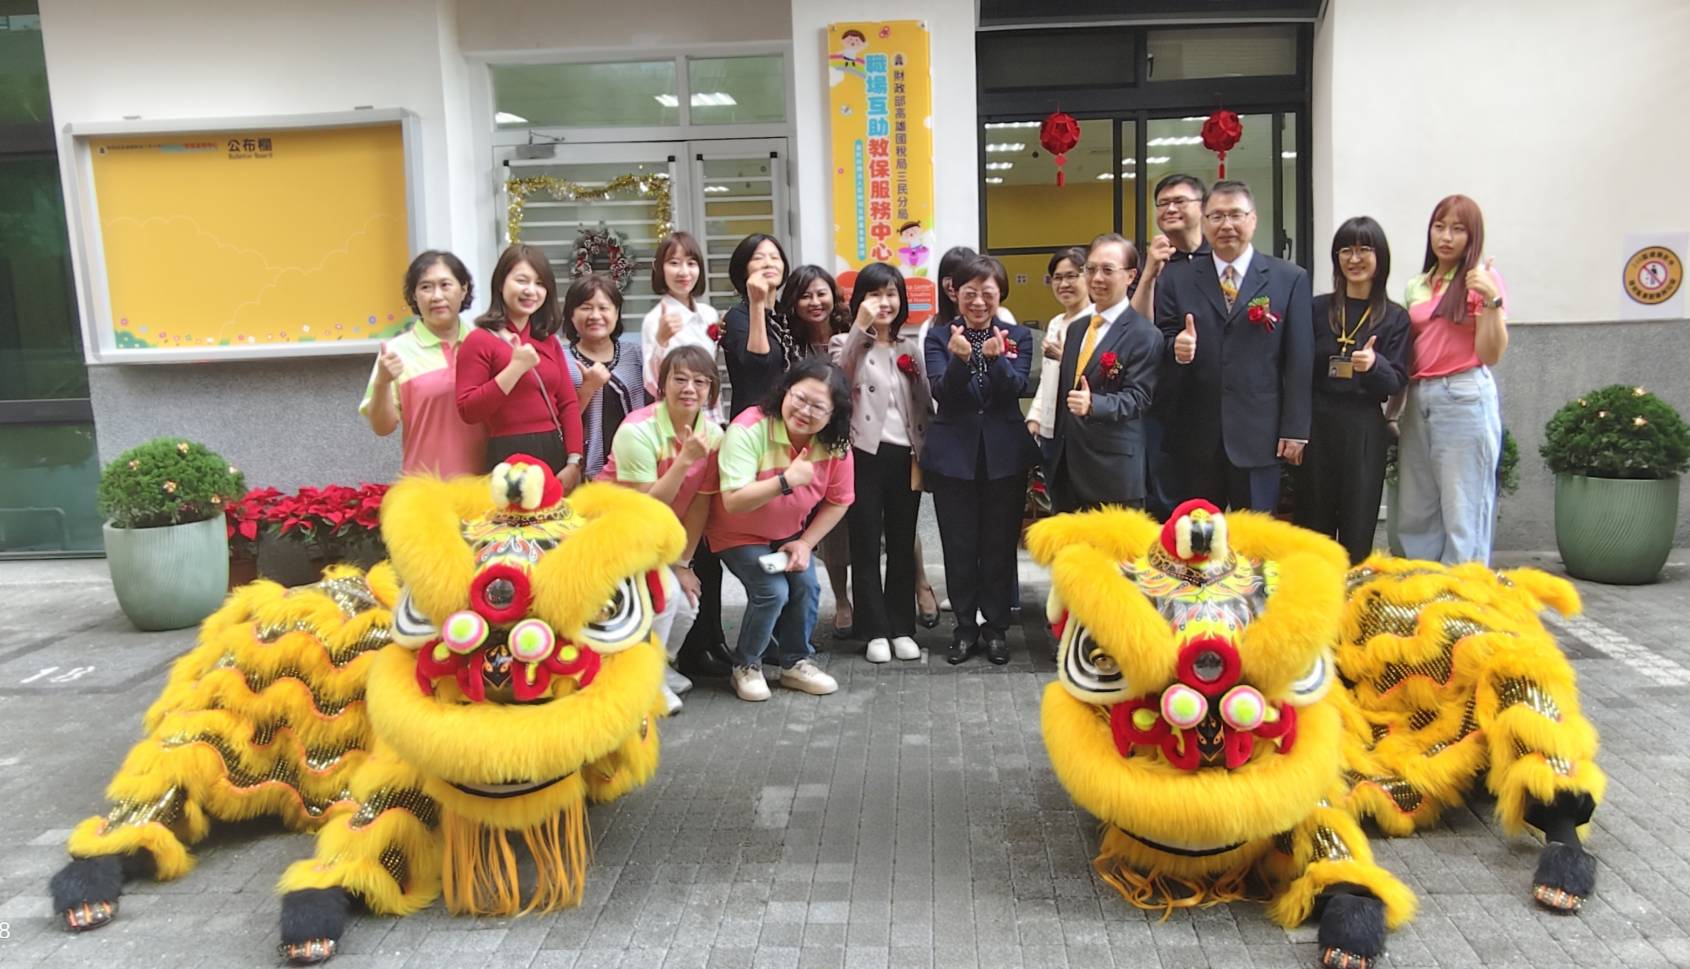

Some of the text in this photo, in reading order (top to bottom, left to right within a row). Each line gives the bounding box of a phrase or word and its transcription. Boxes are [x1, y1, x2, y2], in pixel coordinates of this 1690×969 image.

[227, 138, 272, 152] 公布欄
[866, 54, 892, 261] 職場互助教保服務中心
